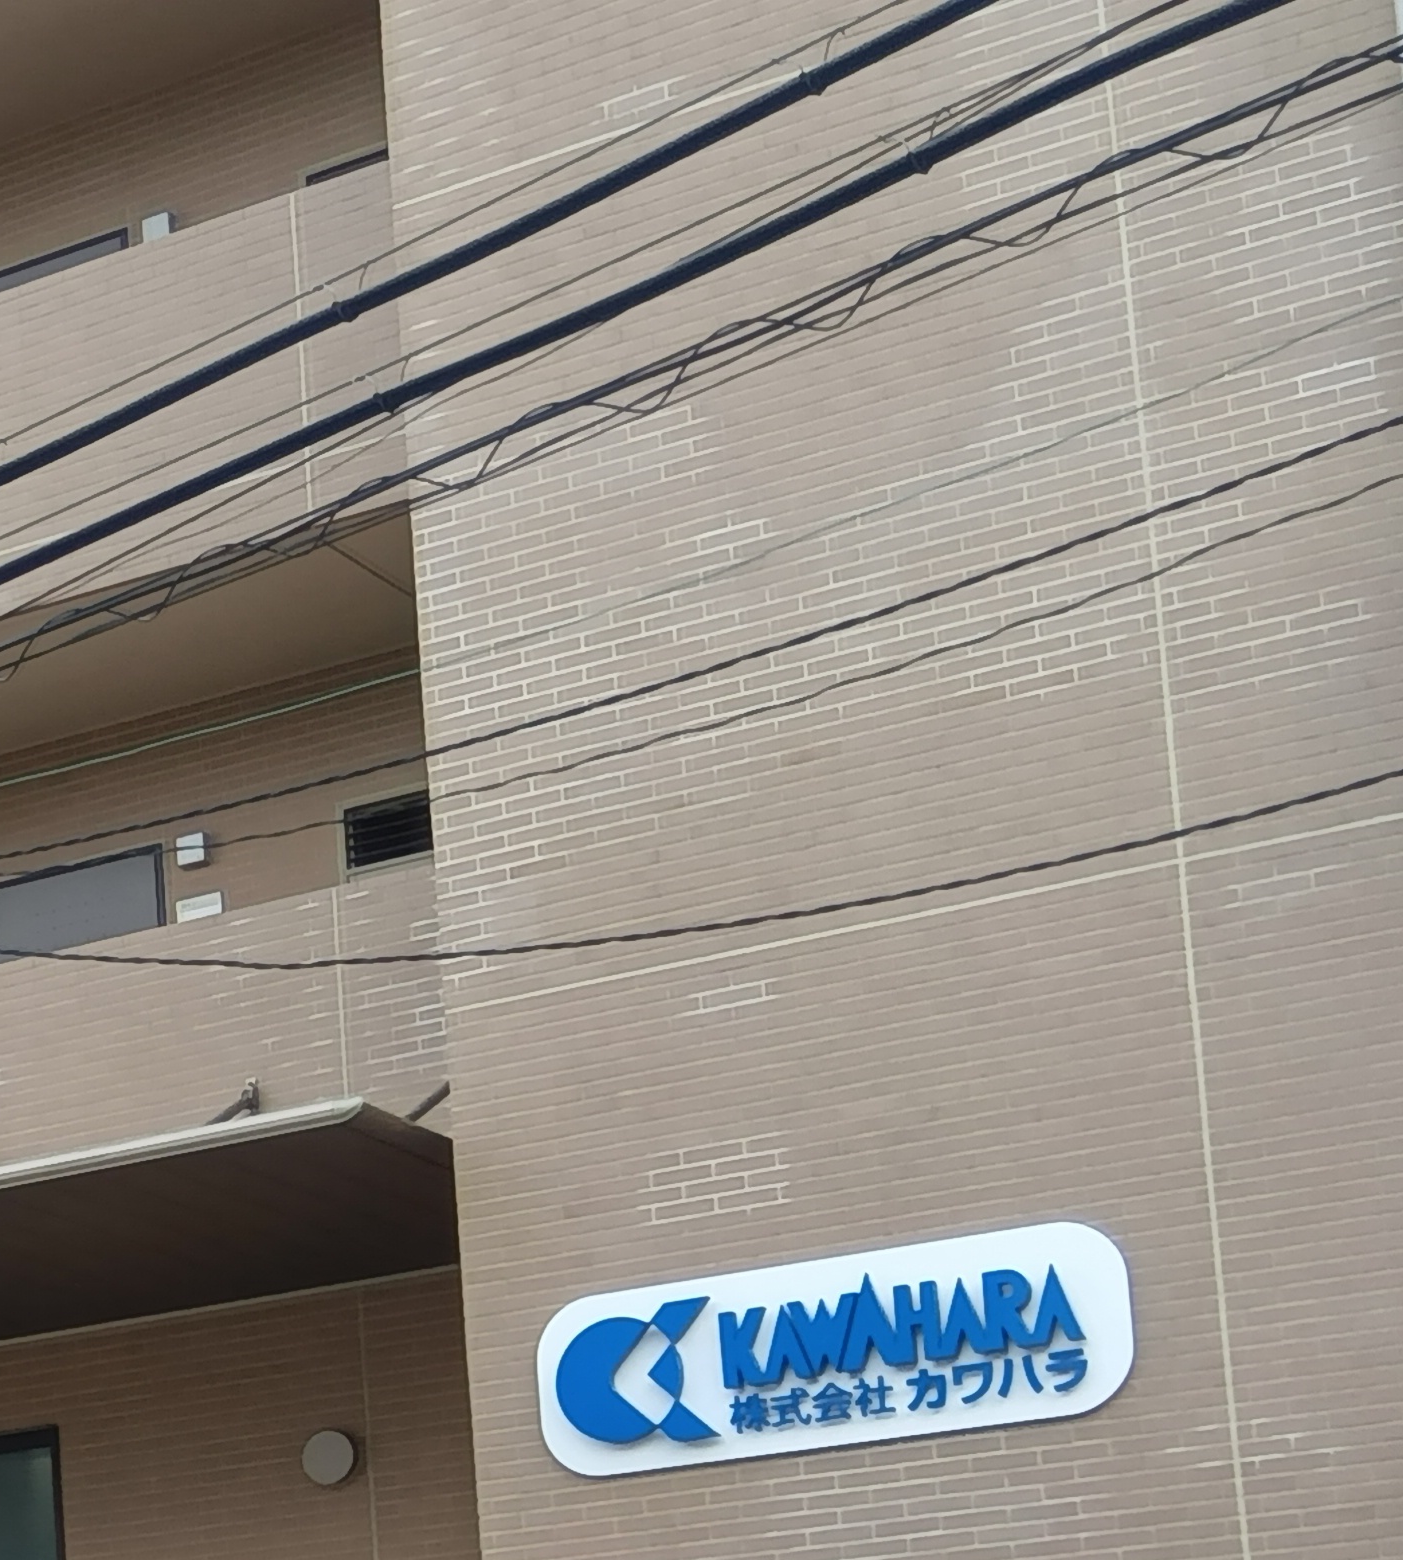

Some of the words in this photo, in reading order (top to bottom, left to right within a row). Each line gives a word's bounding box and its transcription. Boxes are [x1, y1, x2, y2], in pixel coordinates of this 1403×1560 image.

[717, 1263, 1086, 1391] KAWAHARA
[728, 1376, 895, 1435] 株式会社
[905, 1346, 1089, 1413] カワハラ
